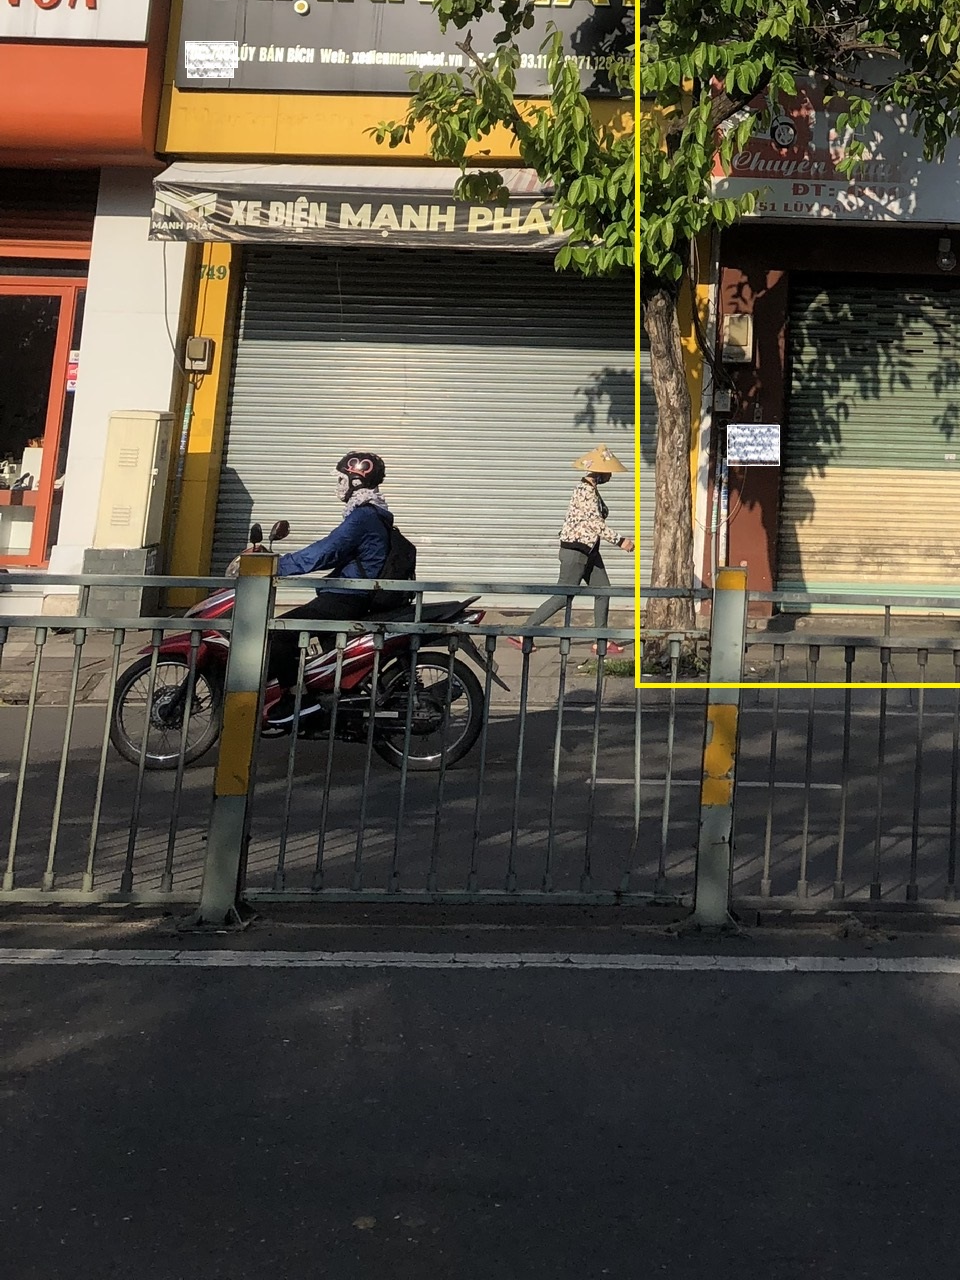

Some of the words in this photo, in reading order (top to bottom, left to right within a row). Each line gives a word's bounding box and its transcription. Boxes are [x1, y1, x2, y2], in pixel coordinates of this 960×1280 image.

[259, 44, 284, 62] BÁN
[286, 45, 314, 63] BÍCH
[320, 48, 350, 64] Web:
[792, 183, 836, 197] ĐT:
[228, 200, 263, 226] XE
[268, 196, 327, 233] ĐIỆN
[339, 202, 456, 238] MẠNH
[200, 264, 228, 280] 749
